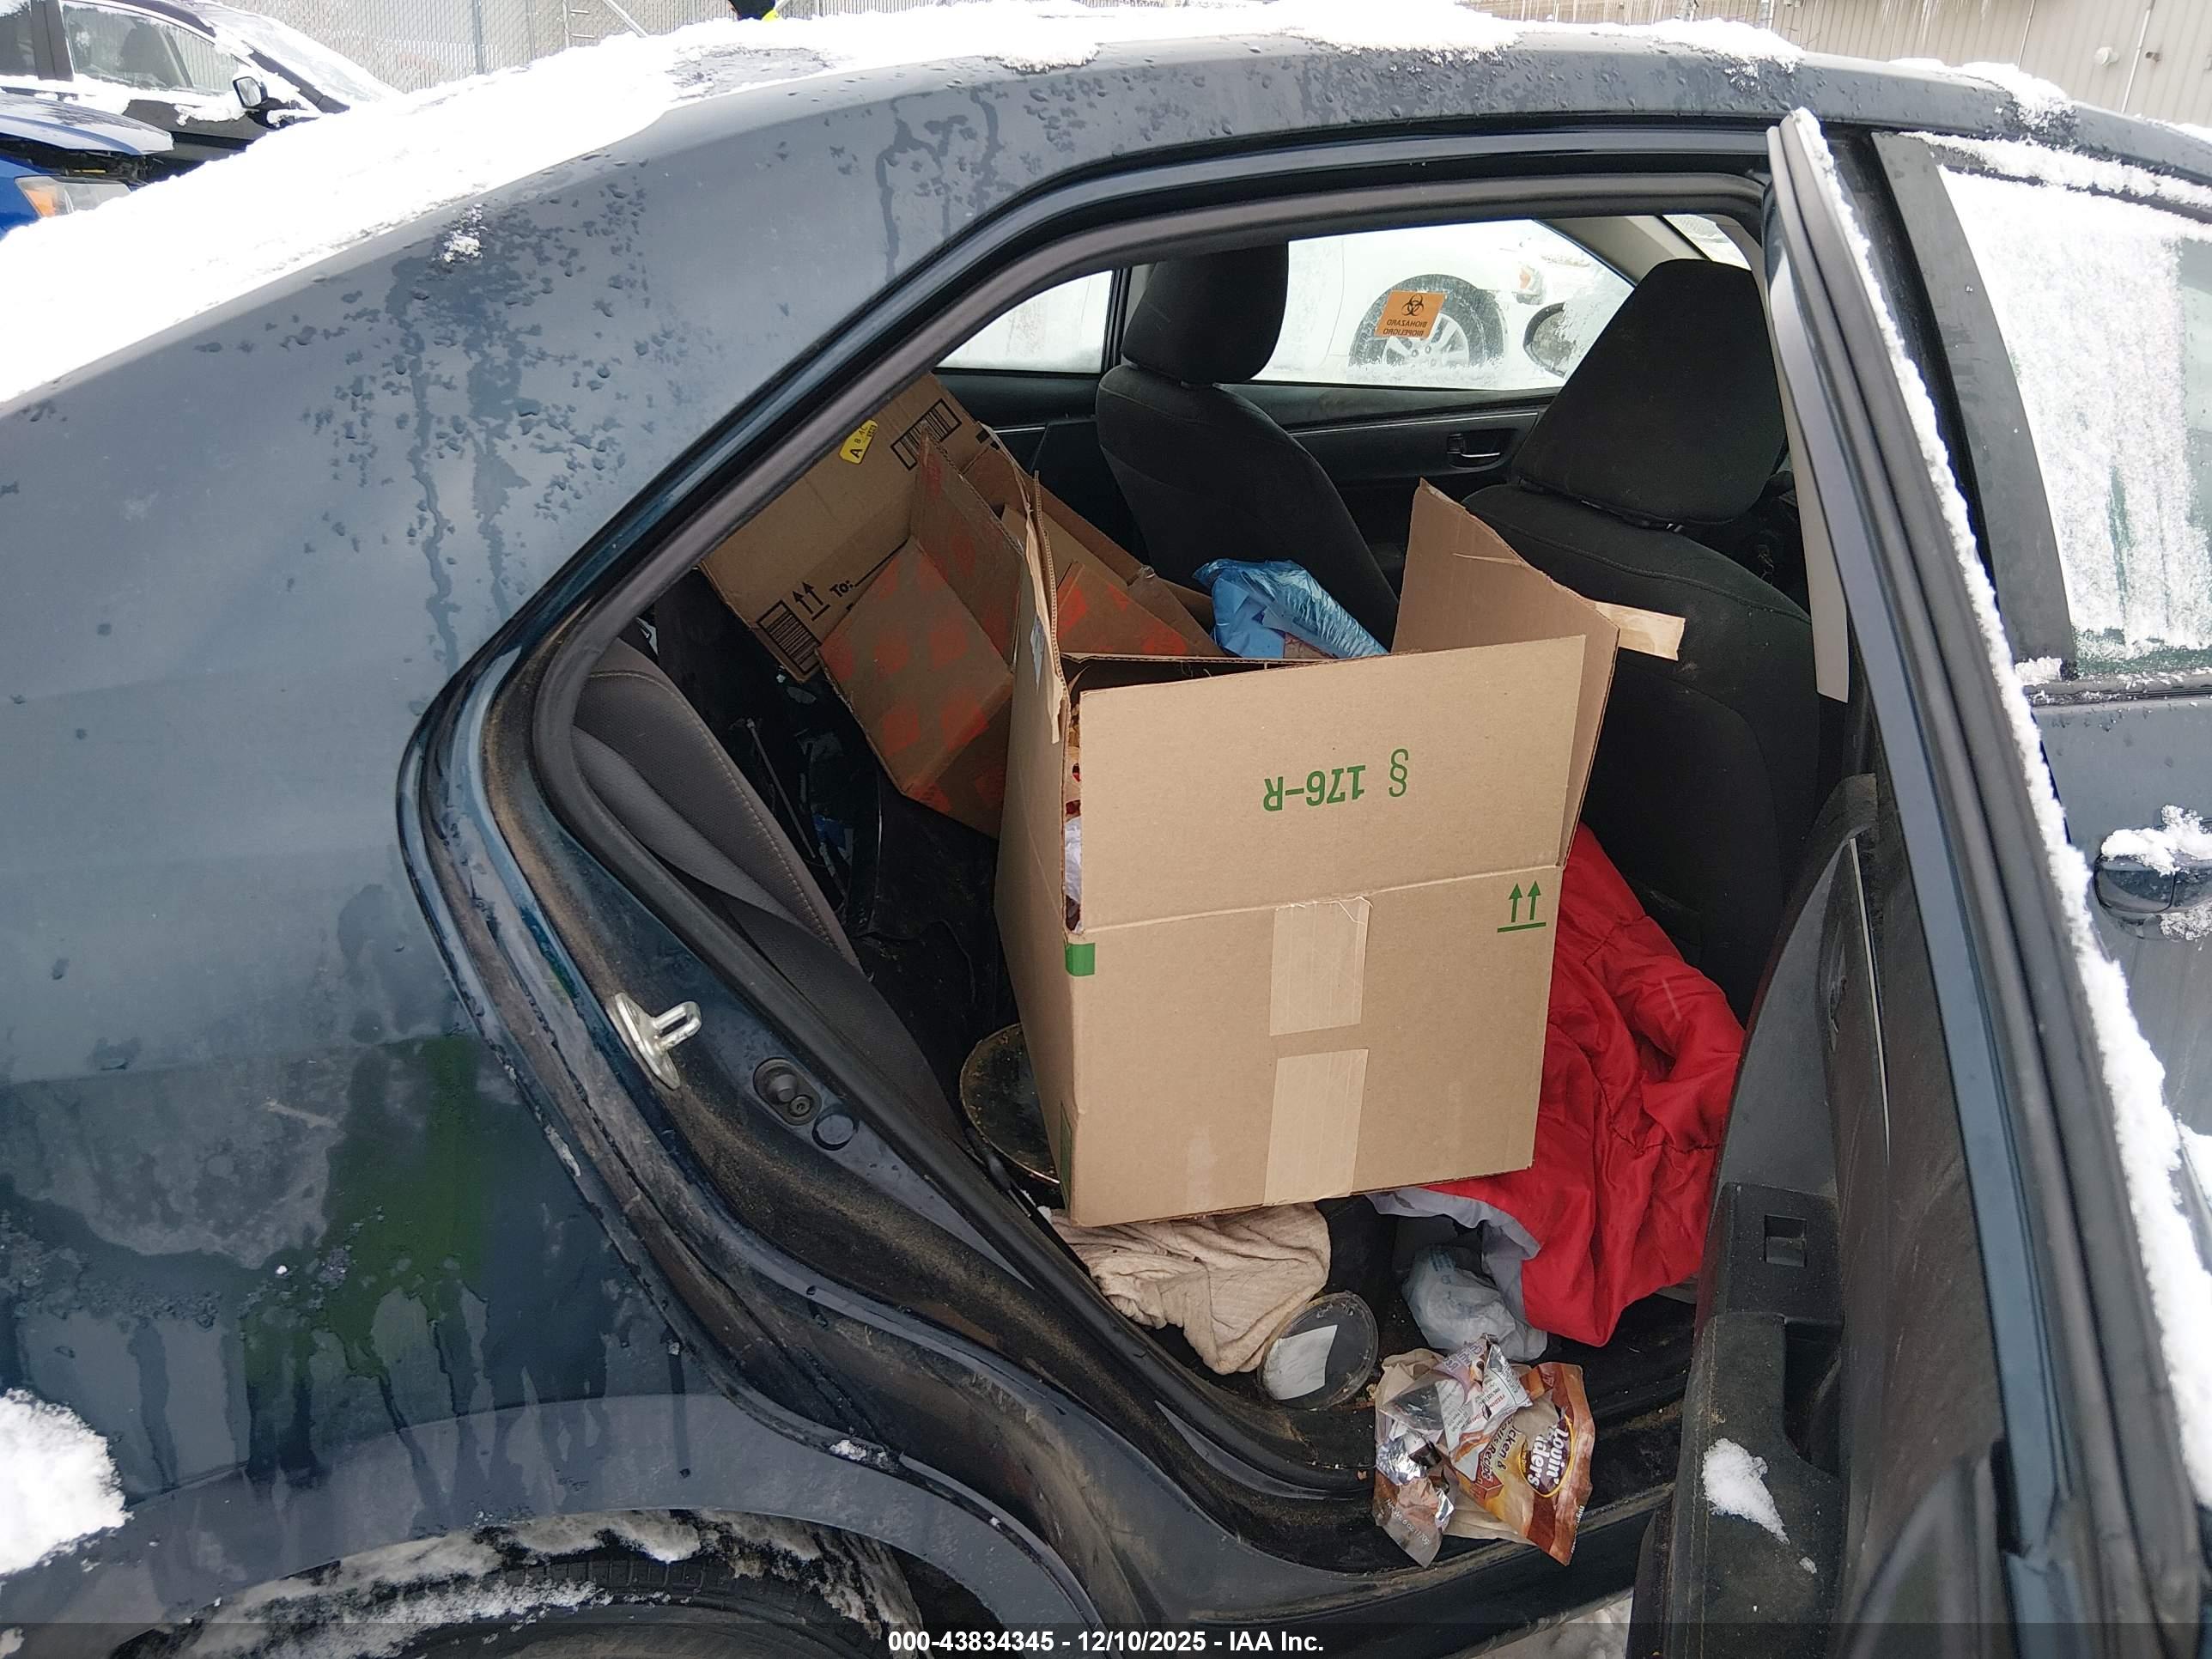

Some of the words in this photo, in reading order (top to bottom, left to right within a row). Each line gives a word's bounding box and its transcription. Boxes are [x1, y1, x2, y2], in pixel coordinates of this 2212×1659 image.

[830, 580, 854, 598] To:
[1263, 764, 1366, 812] 176-R
[1481, 1443, 1497, 1480] Recipe
[1497, 1460, 1507, 1470] &
